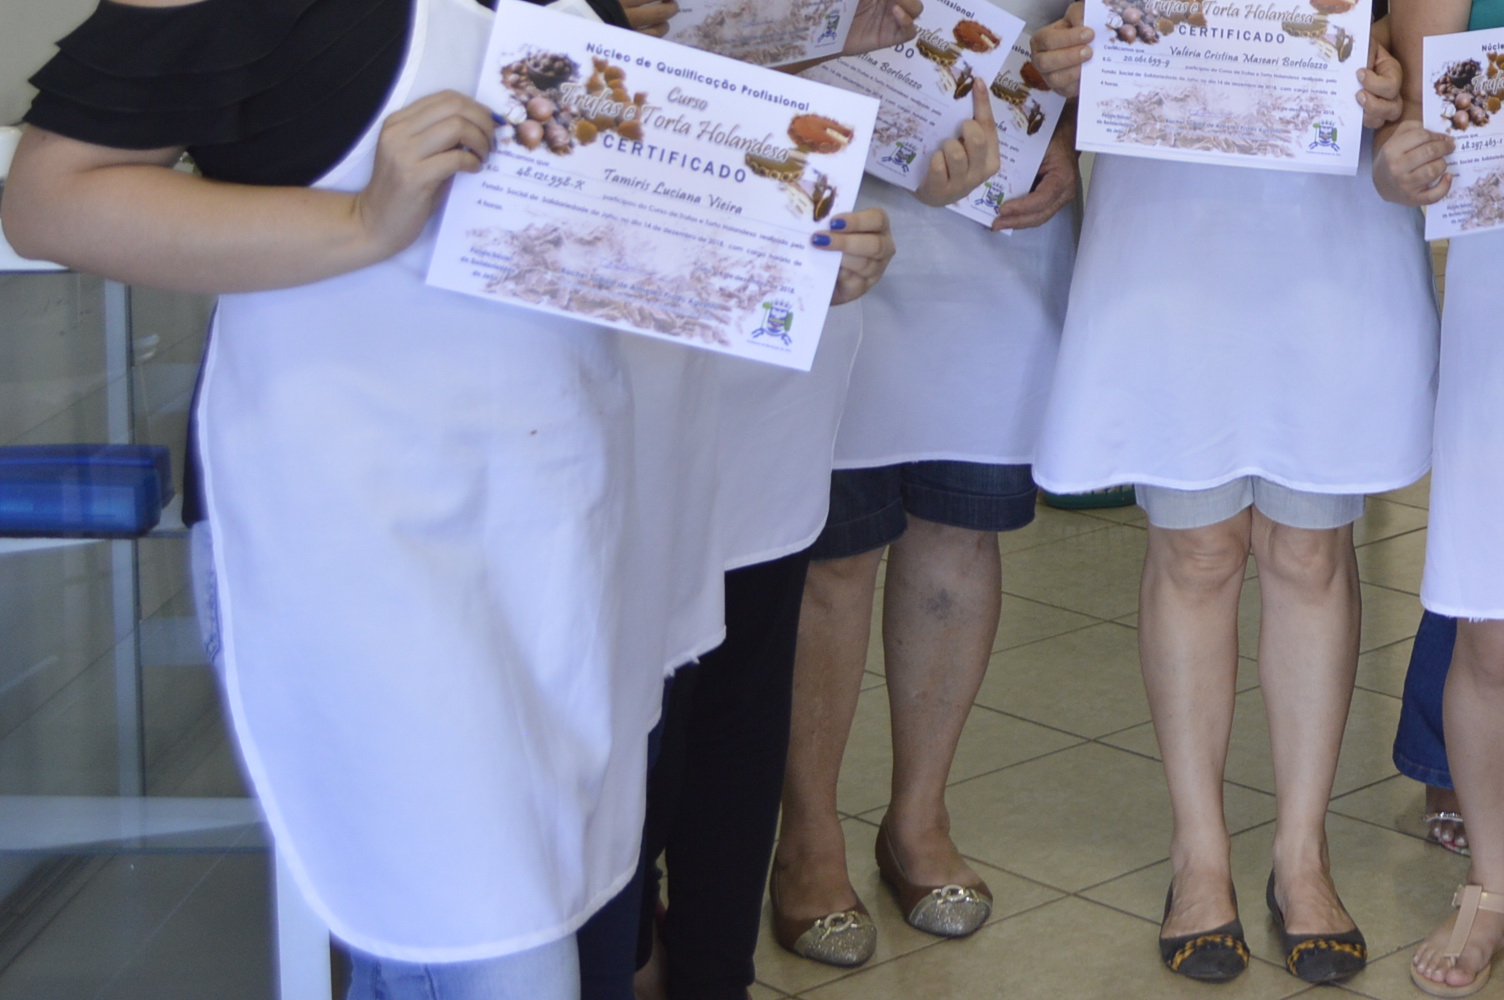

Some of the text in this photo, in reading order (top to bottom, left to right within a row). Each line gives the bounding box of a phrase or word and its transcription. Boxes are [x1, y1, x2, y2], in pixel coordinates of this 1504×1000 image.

[1190, 1, 1199, 15] e
[1243, 0, 1315, 25] Holandesa
[1177, 23, 1286, 44] CERTIFICADO
[1203, 47, 1239, 62] Cristina
[584, 41, 635, 65] Núcleo
[635, 55, 653, 70] de
[654, 60, 738, 95] Qualificação
[739, 83, 811, 112] Profissional
[665, 85, 710, 113] Curso
[554, 78, 793, 164] Trufas e Torta Holandesa
[600, 133, 748, 184] CERTIFICADO
[601, 166, 745, 216] Tamiris Luciana Vieira
